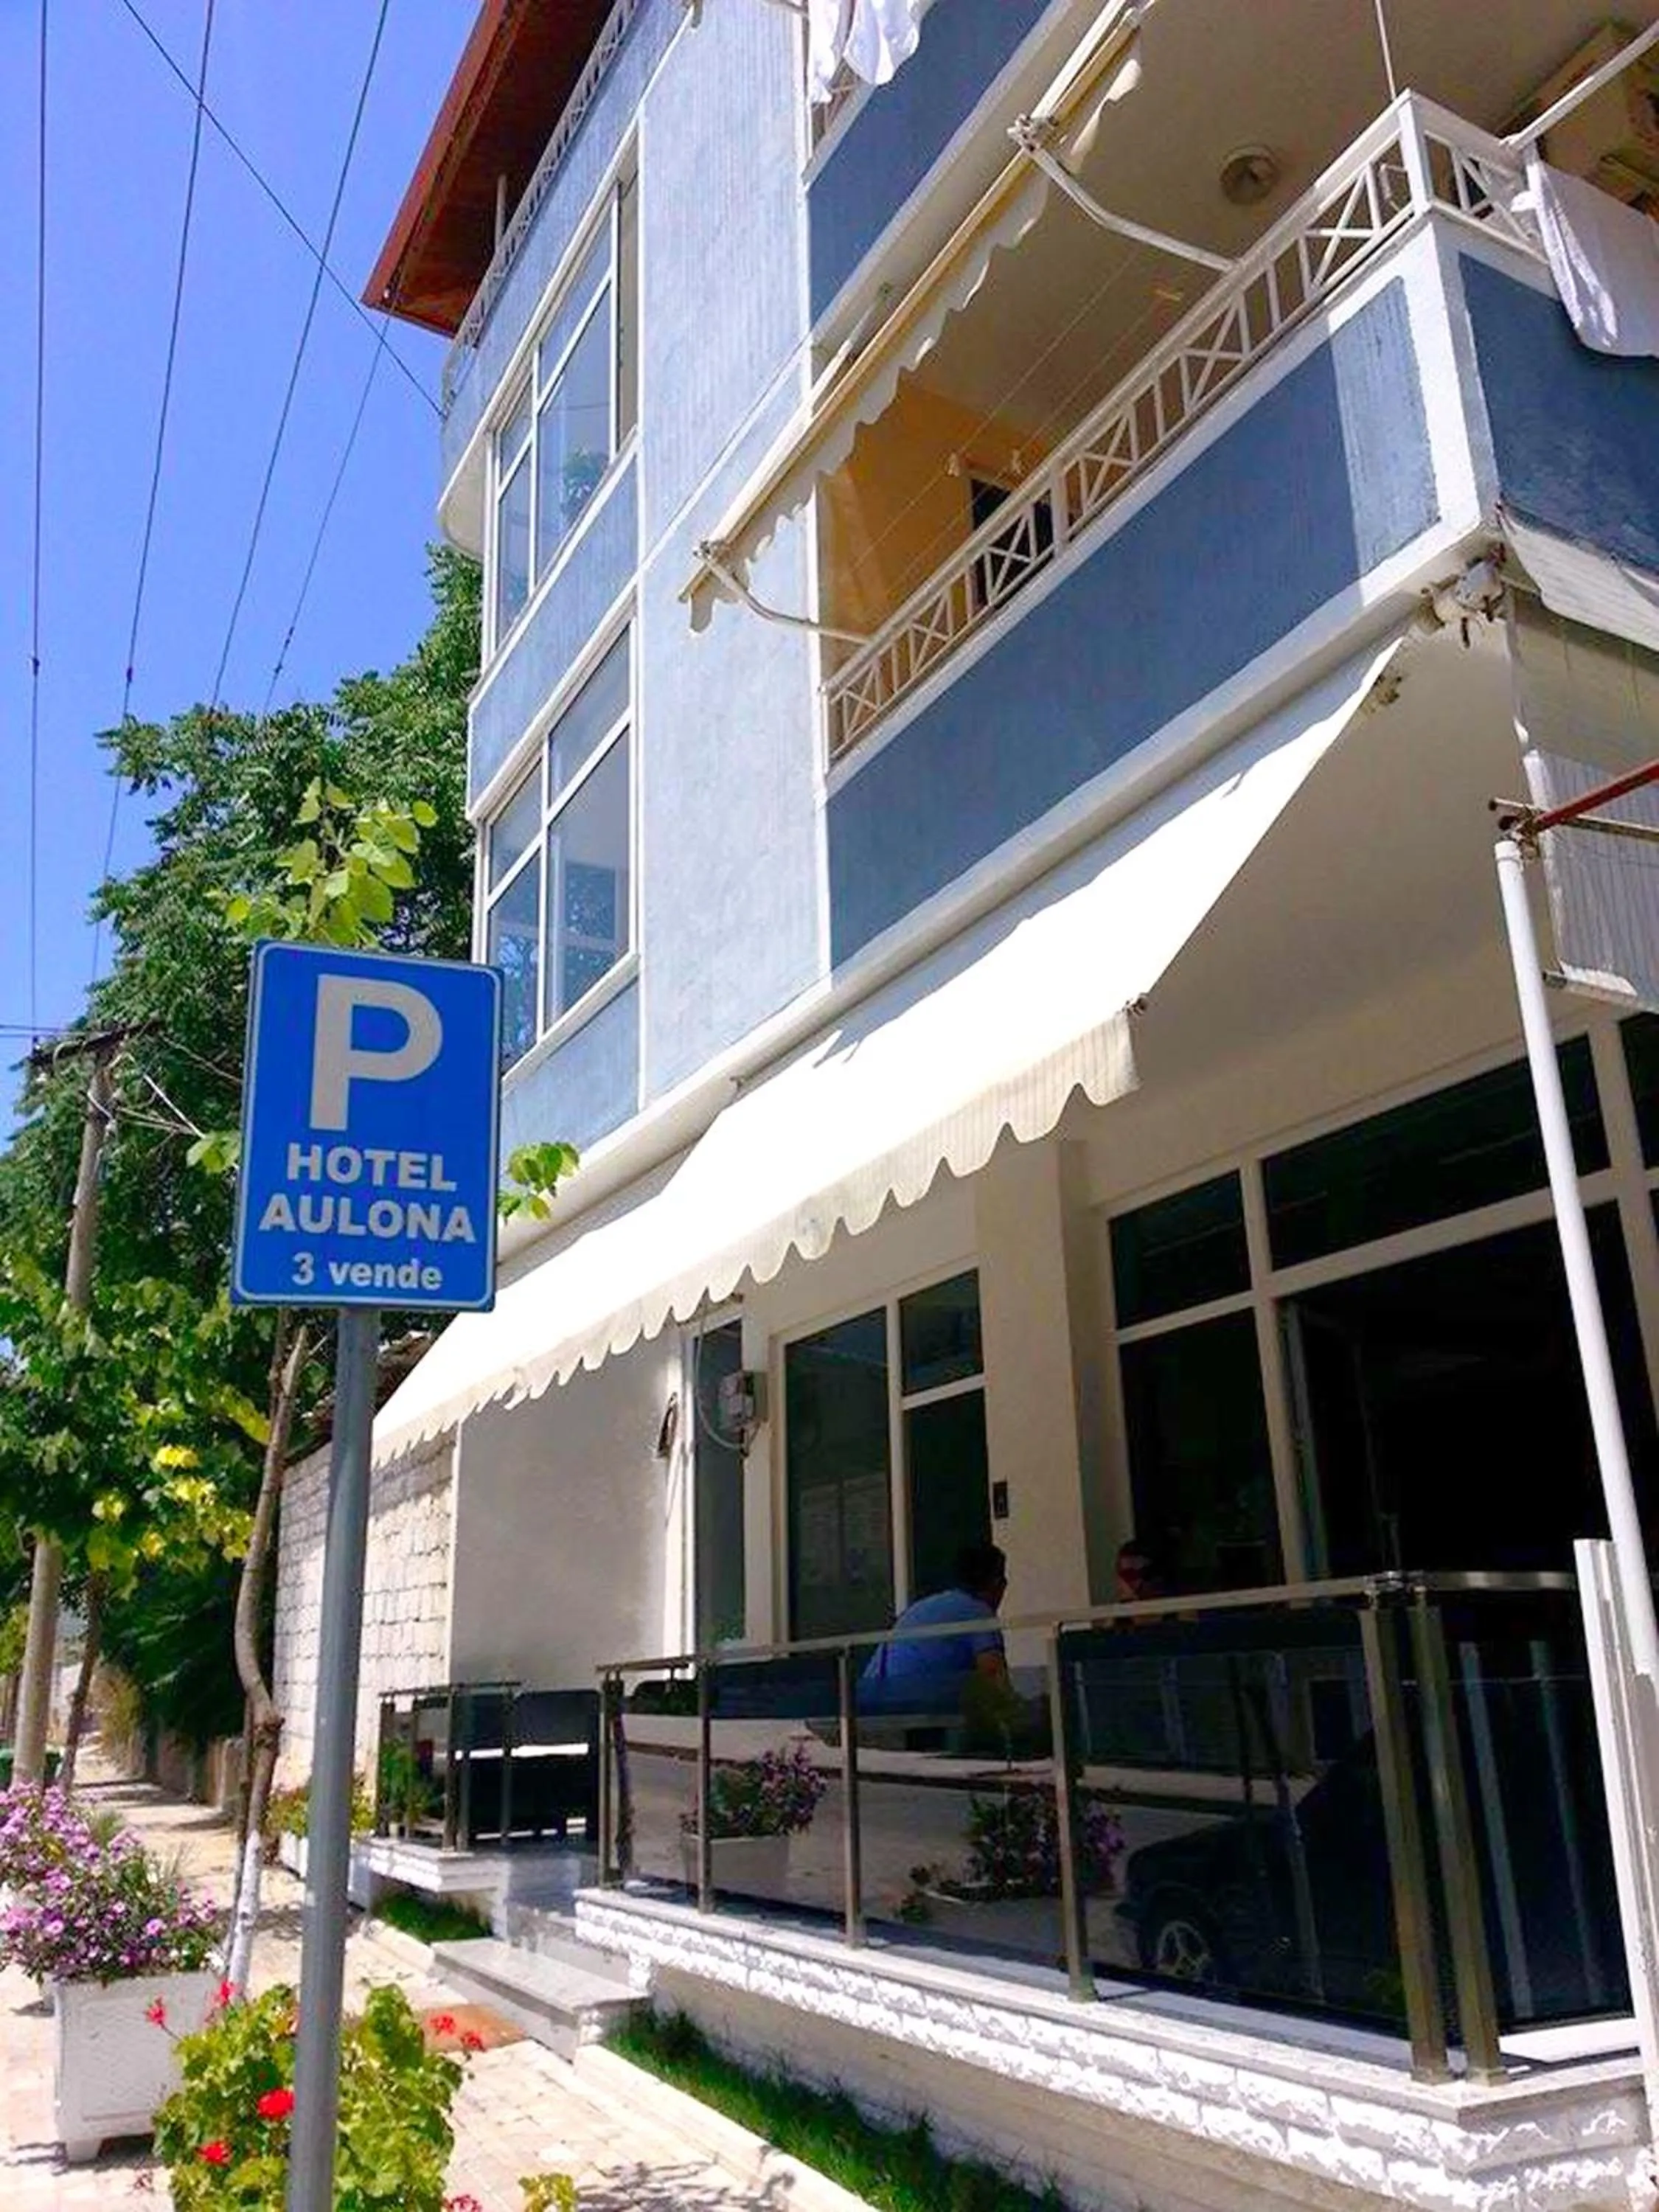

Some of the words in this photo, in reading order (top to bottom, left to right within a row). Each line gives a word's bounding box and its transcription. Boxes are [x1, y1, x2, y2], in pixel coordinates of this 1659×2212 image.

[310, 974, 442, 1130] P
[288, 1142, 456, 1191] HOTEL
[259, 1194, 476, 1242] AULONA
[292, 1251, 315, 1285] 3
[329, 1258, 442, 1290] vende
